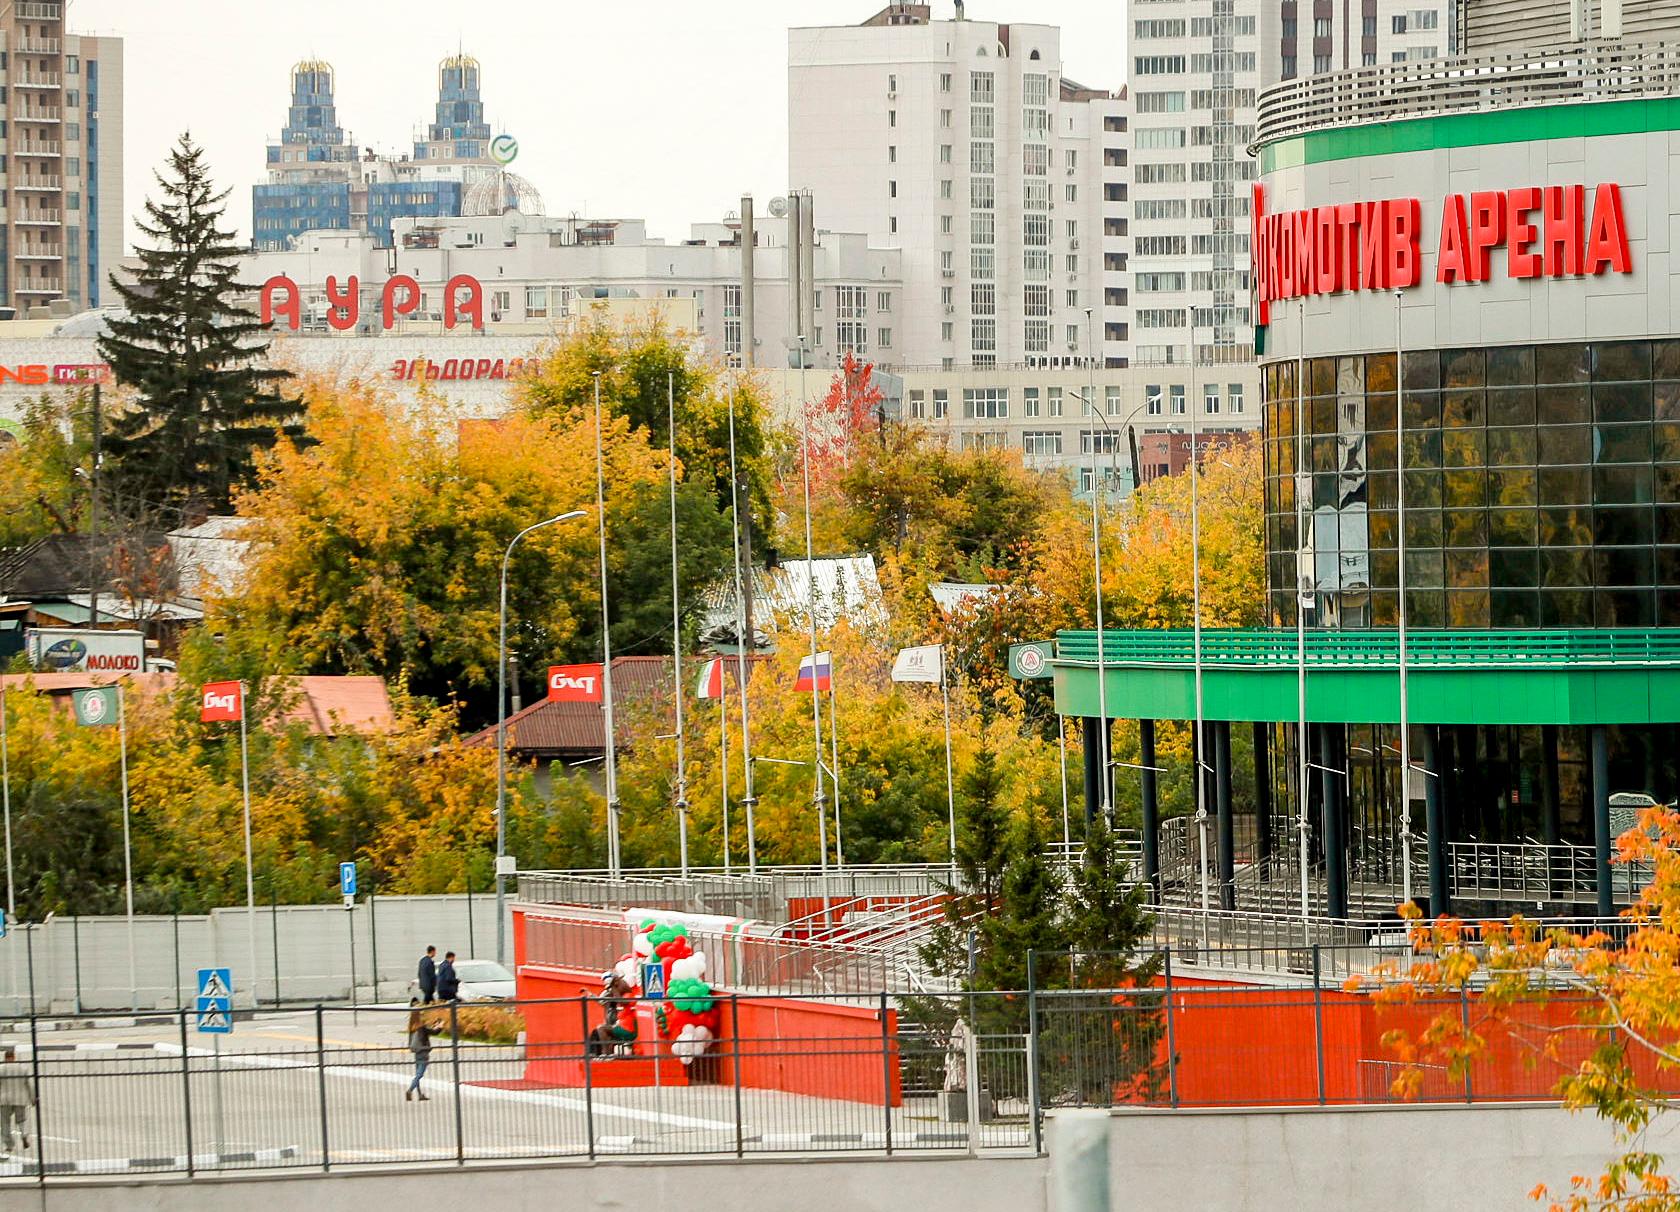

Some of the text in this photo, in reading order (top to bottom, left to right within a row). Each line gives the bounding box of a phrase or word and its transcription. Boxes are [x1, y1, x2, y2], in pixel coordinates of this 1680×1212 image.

[1436, 183, 1632, 283] АРЕНА
[260, 274, 483, 330] АУРА
[59, 368, 104, 380] ГИЕР
[387, 358, 541, 380] ЭЬДОРА
[86, 655, 139, 670] МОЛОКО
